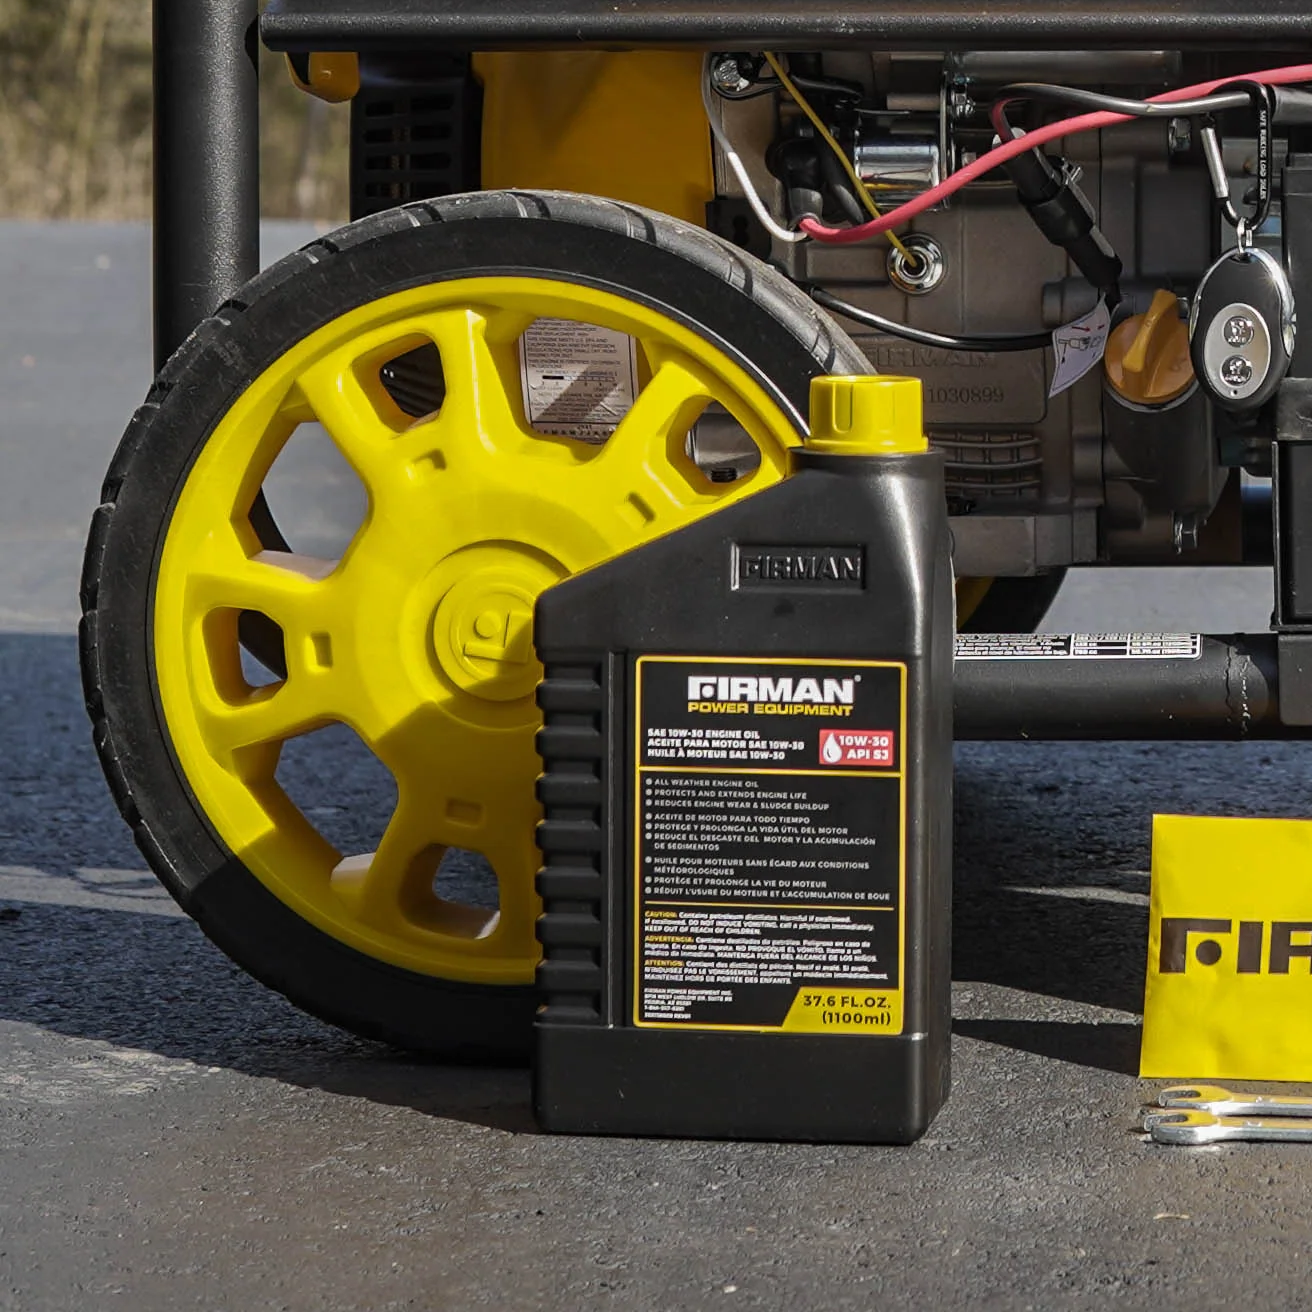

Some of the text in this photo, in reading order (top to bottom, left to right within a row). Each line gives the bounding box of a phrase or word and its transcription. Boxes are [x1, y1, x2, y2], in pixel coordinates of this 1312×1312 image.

[746, 555, 860, 579] FIRMAN
[687, 675, 853, 703] FIRMAN
[687, 702, 853, 715] POWER EQUIPMENT
[647, 728, 760, 741] SAE 10W-30 ENGINE OIL
[837, 735, 888, 748] 10W-30
[846, 749, 888, 760] API SJ
[803, 995, 890, 1008] 37.6 FL.OZ.
[822, 1010, 890, 1025] (1100ml)
